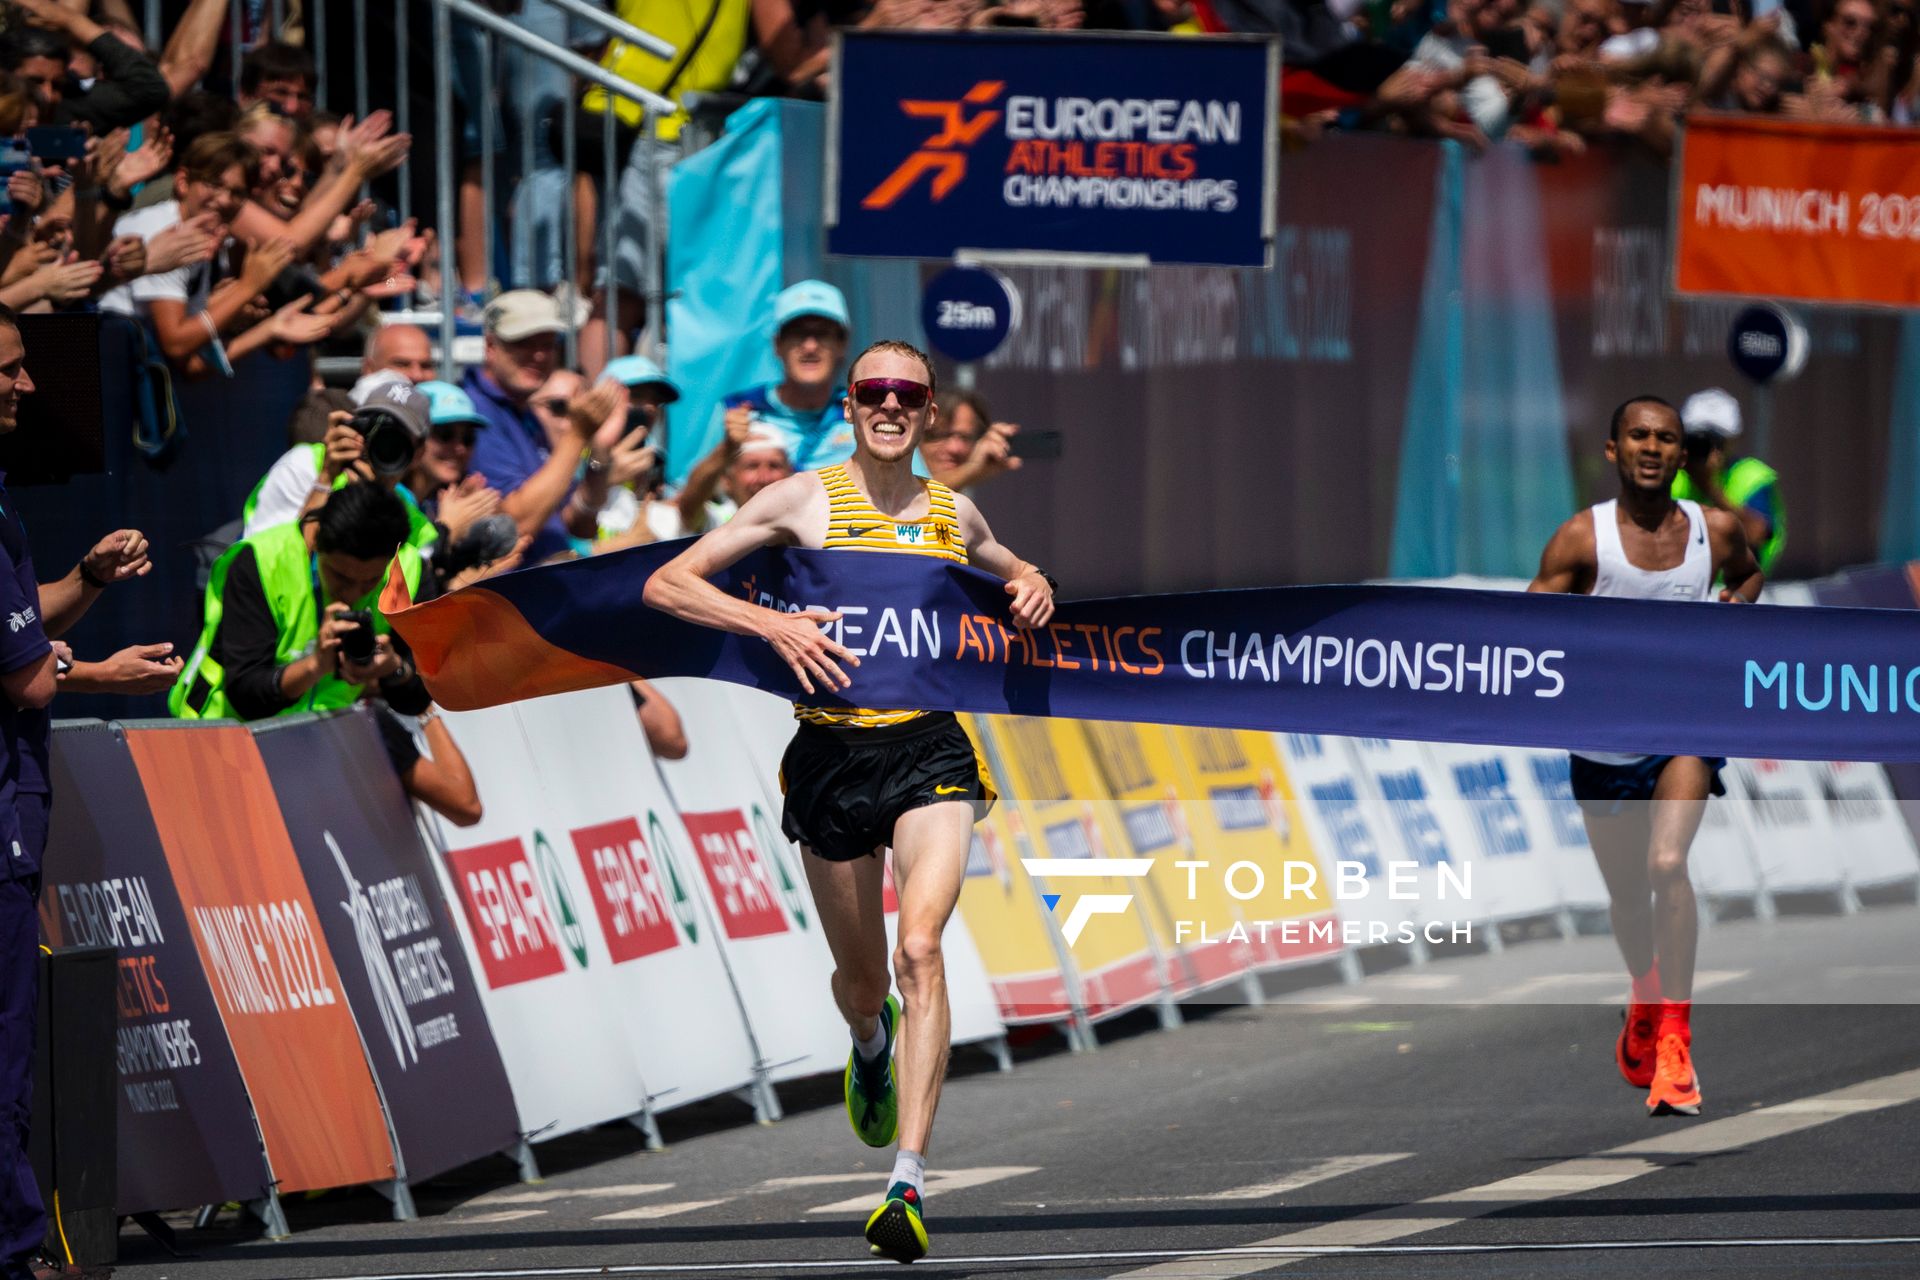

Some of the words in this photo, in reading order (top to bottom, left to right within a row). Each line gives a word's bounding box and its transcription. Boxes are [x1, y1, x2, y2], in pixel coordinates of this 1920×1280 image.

[1005, 95, 1241, 144] EUROPEAN
[1003, 175, 1238, 212] CHAMPIONSHIPS
[1005, 141, 1198, 180] ATHLETICS
[1696, 183, 1849, 236] MUNICH
[936, 300, 996, 329] 25m
[956, 614, 1165, 675] ATHLETICS
[1180, 629, 1565, 698] CHAMPIONSHIPS
[593, 838, 670, 937] SPAR
[700, 829, 778, 915] SPAR
[58, 876, 164, 948] EUROPEAN
[466, 860, 557, 960] SPAR
[194, 903, 286, 1013] MUNICH
[260, 899, 335, 1009] 2022
